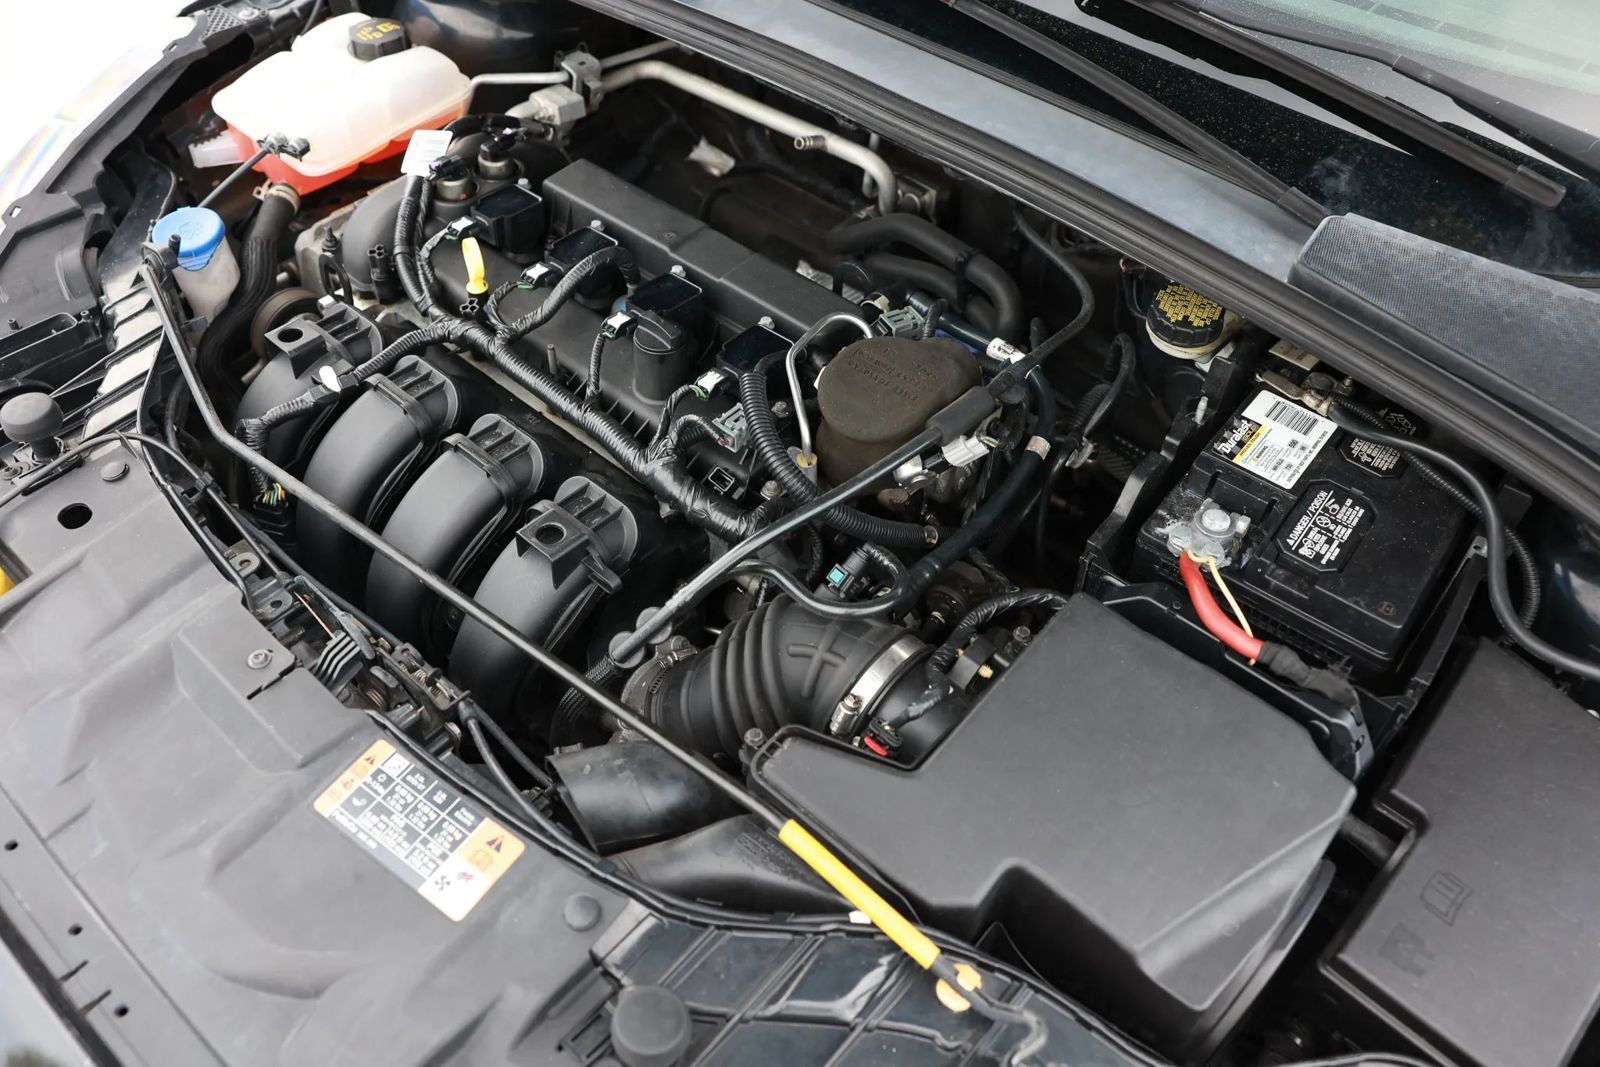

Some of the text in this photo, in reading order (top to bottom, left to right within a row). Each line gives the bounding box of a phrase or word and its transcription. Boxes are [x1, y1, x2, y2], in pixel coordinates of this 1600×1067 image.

[1217, 418, 1252, 453] Duralast
[1241, 424, 1256, 441] GOLD
[1239, 442, 1252, 456] PROVEN
[1289, 514, 1310, 540] DANGER
[1308, 489, 1327, 512] POISON
